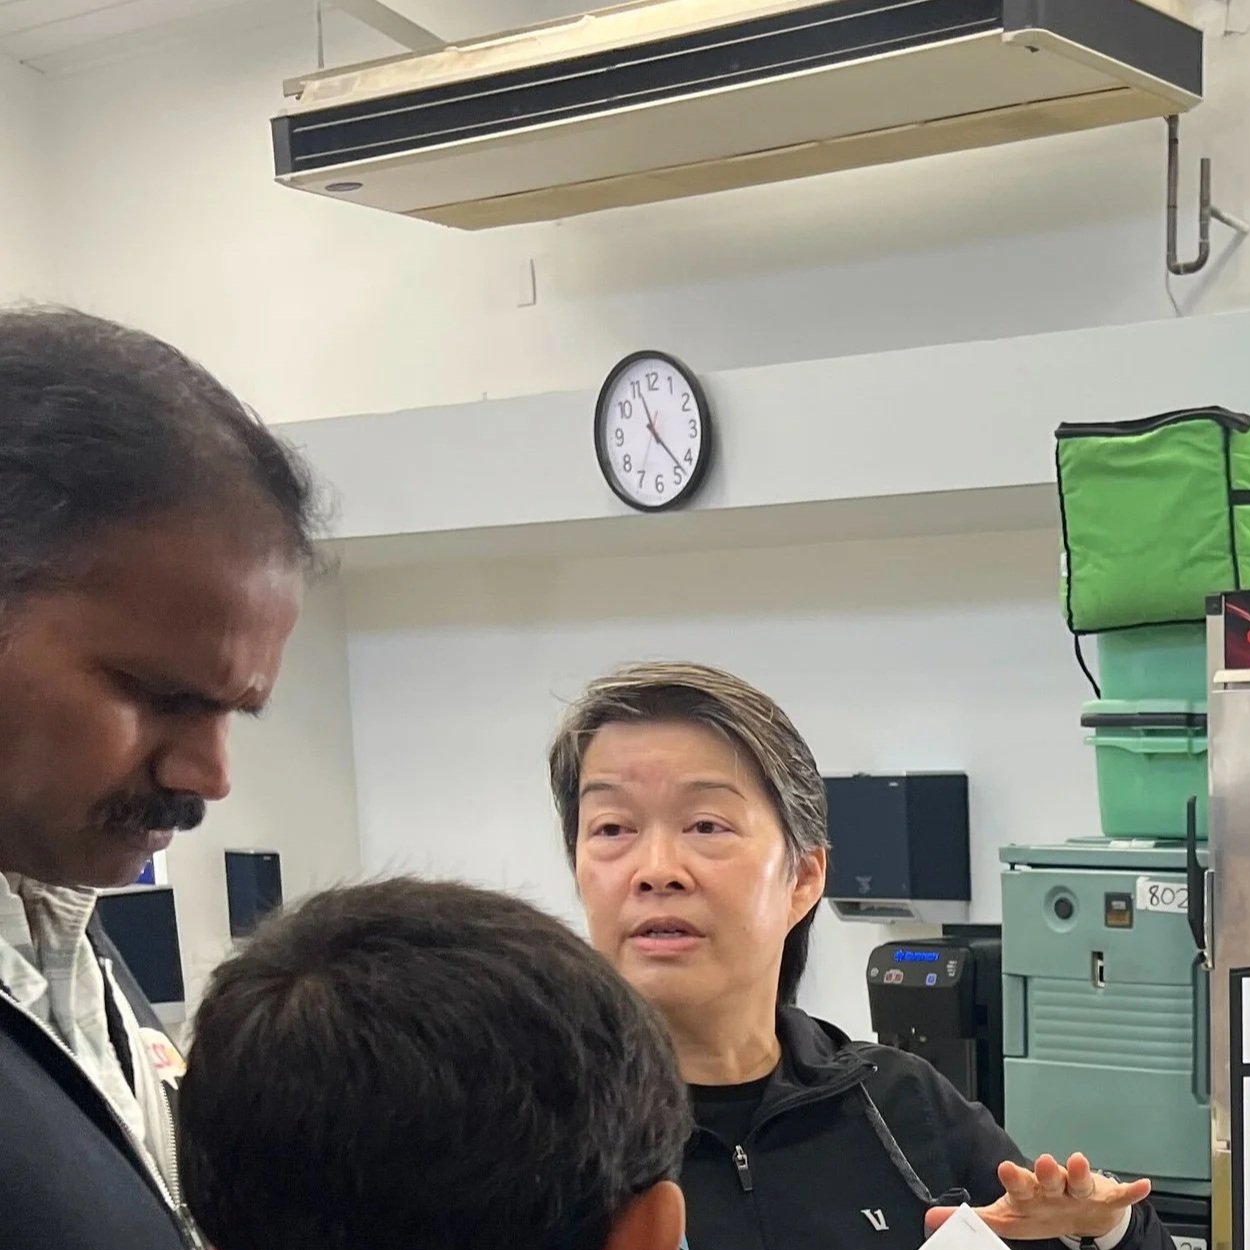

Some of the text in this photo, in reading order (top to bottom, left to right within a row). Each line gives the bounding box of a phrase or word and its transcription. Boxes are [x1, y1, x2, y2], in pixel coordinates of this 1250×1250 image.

[630, 381, 642, 399] 11
[645, 372, 659, 391] 12
[668, 377, 673, 394] 1
[618, 400, 632, 419] 10
[682, 393, 691, 412] 2
[615, 428, 624, 447] 9
[689, 419, 698, 438] 3
[623, 455, 632, 472] 8
[684, 448, 692, 465] 4
[637, 471, 645, 488] 7
[655, 474, 664, 493] 6
[673, 465, 682, 485] 5
